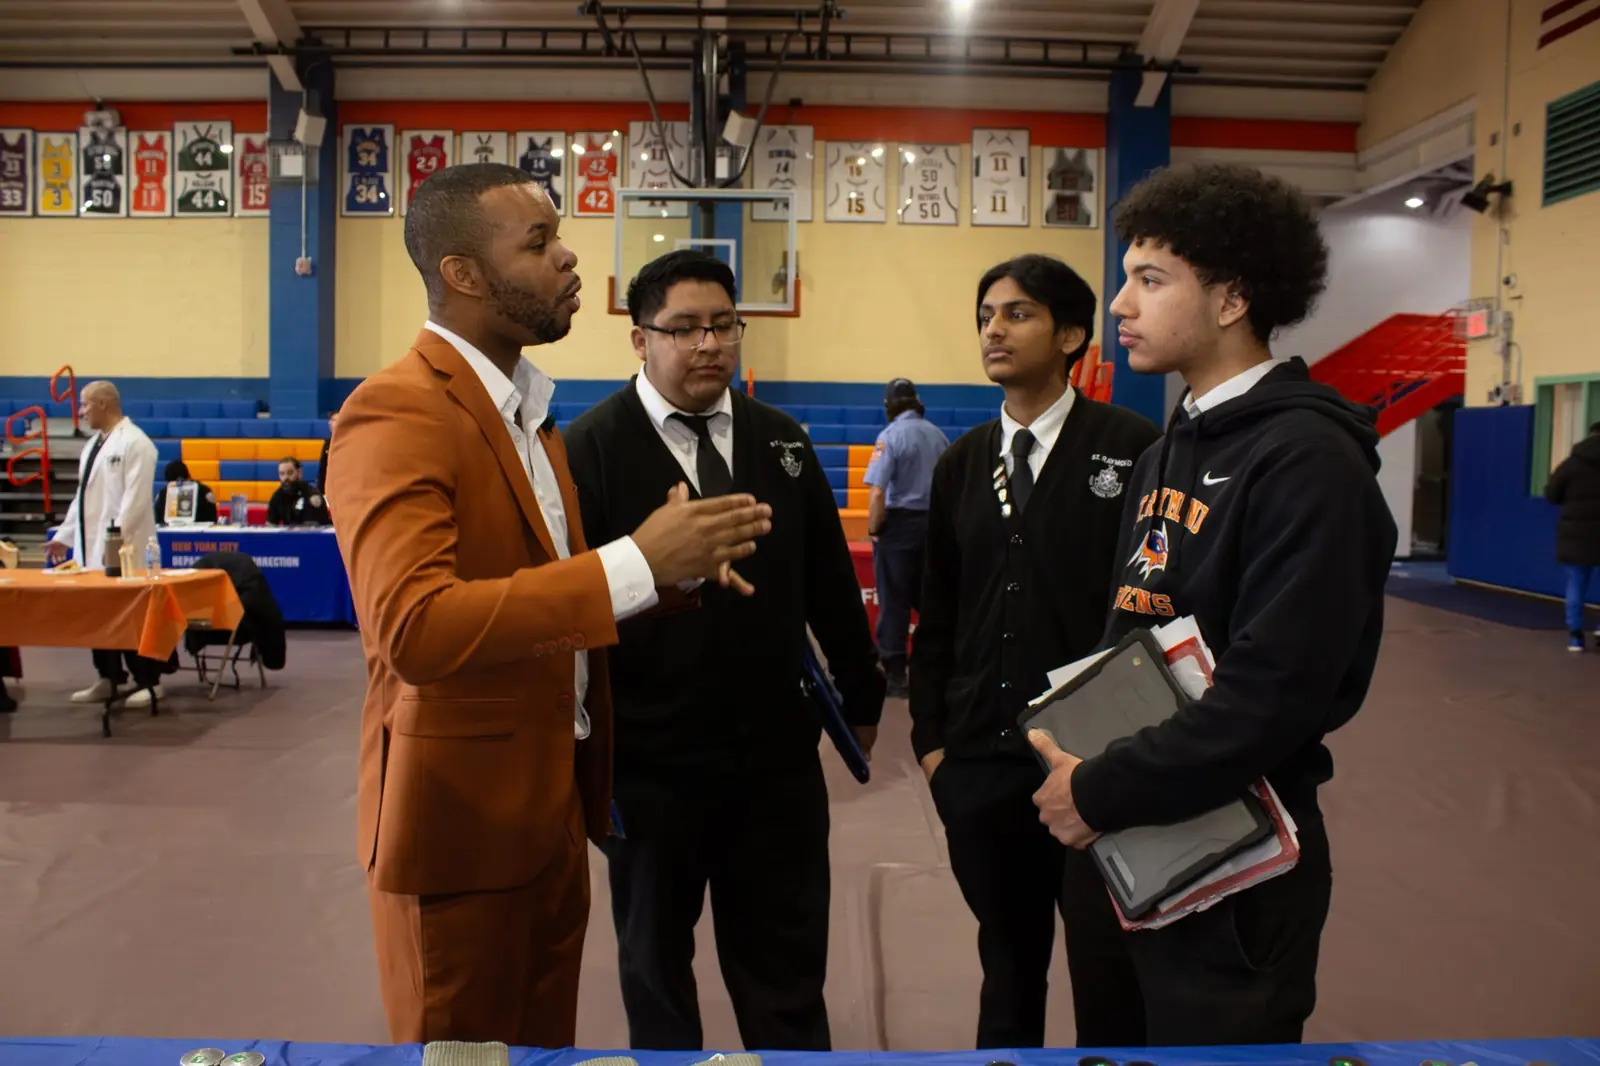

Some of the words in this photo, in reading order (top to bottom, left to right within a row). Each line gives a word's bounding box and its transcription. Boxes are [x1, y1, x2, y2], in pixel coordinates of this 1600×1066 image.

[921, 169, 938, 182] 50
[92, 189, 113, 208] 50
[191, 190, 215, 209] 44
[248, 184, 267, 205] 15
[355, 184, 378, 203] 34
[585, 190, 609, 209] 42
[847, 197, 865, 214] 15
[919, 202, 941, 219] 50
[991, 195, 1008, 213] 11
[172, 541, 192, 552] NEW
[194, 541, 217, 552] YORK
[219, 541, 240, 552] CITY
